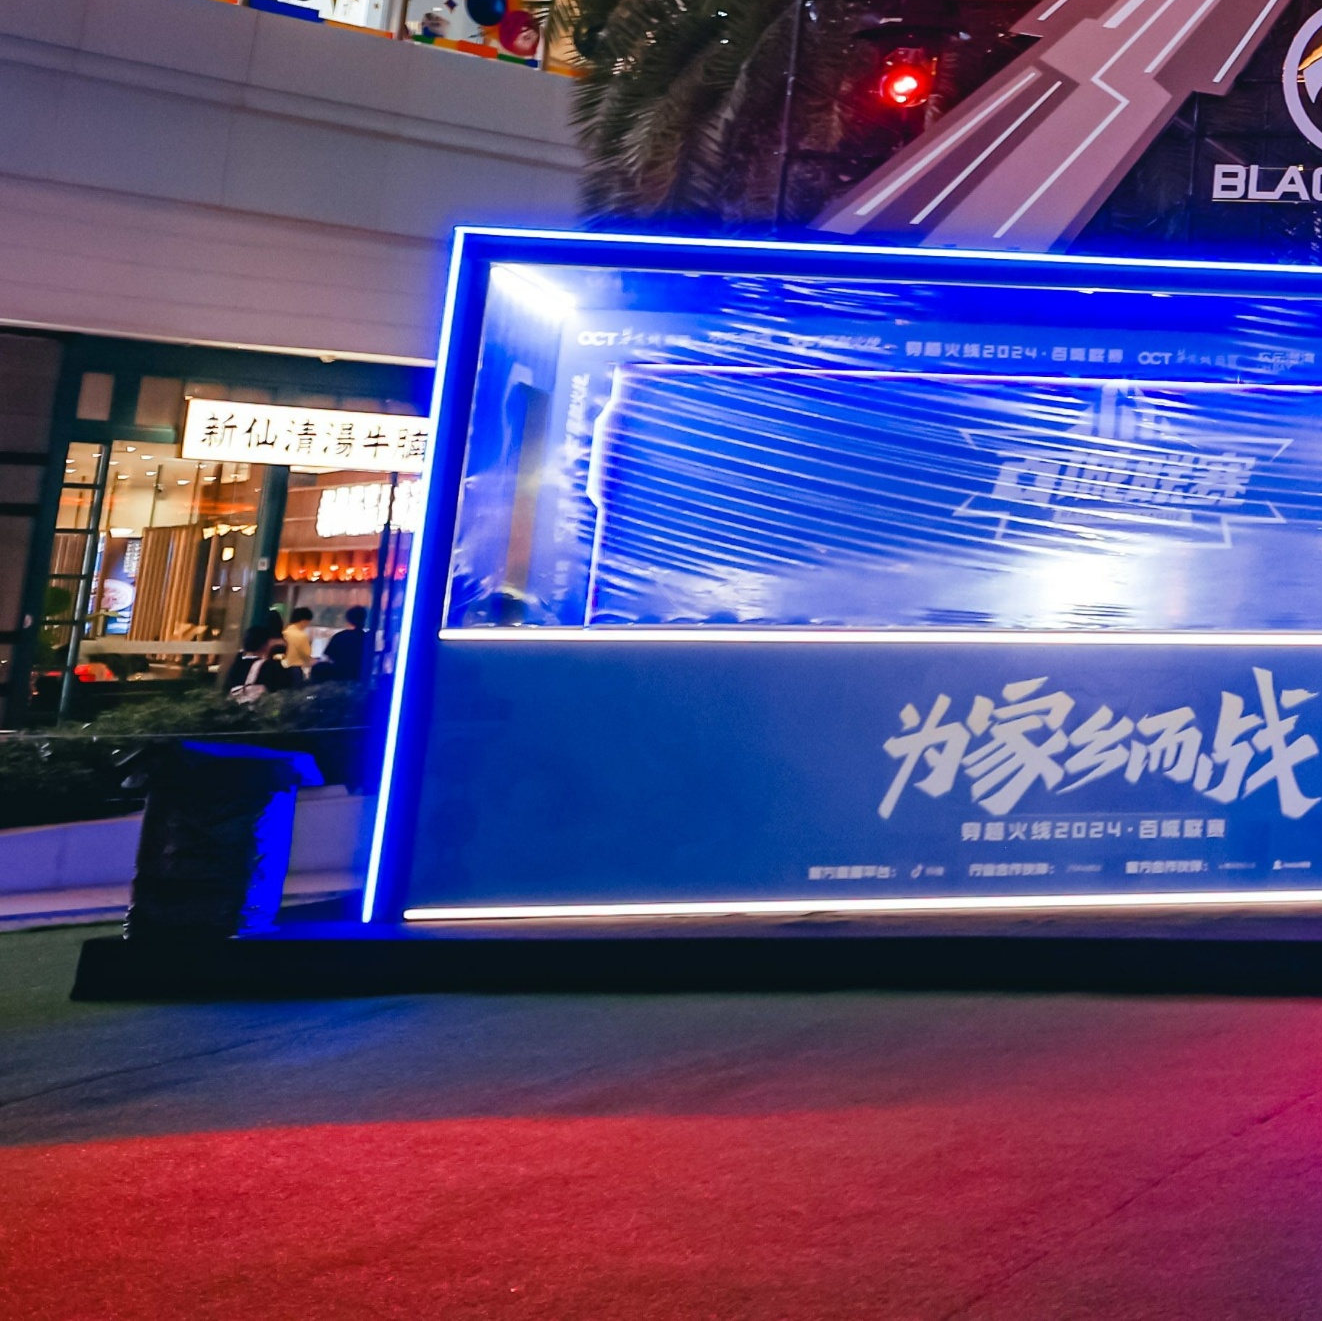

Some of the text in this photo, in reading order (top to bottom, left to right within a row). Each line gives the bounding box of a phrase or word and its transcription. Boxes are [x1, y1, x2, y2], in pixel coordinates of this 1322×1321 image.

[577, 330, 618, 347] OCT
[1138, 351, 1172, 365] OCT
[878, 667, 1322, 819] 为家乡而战
